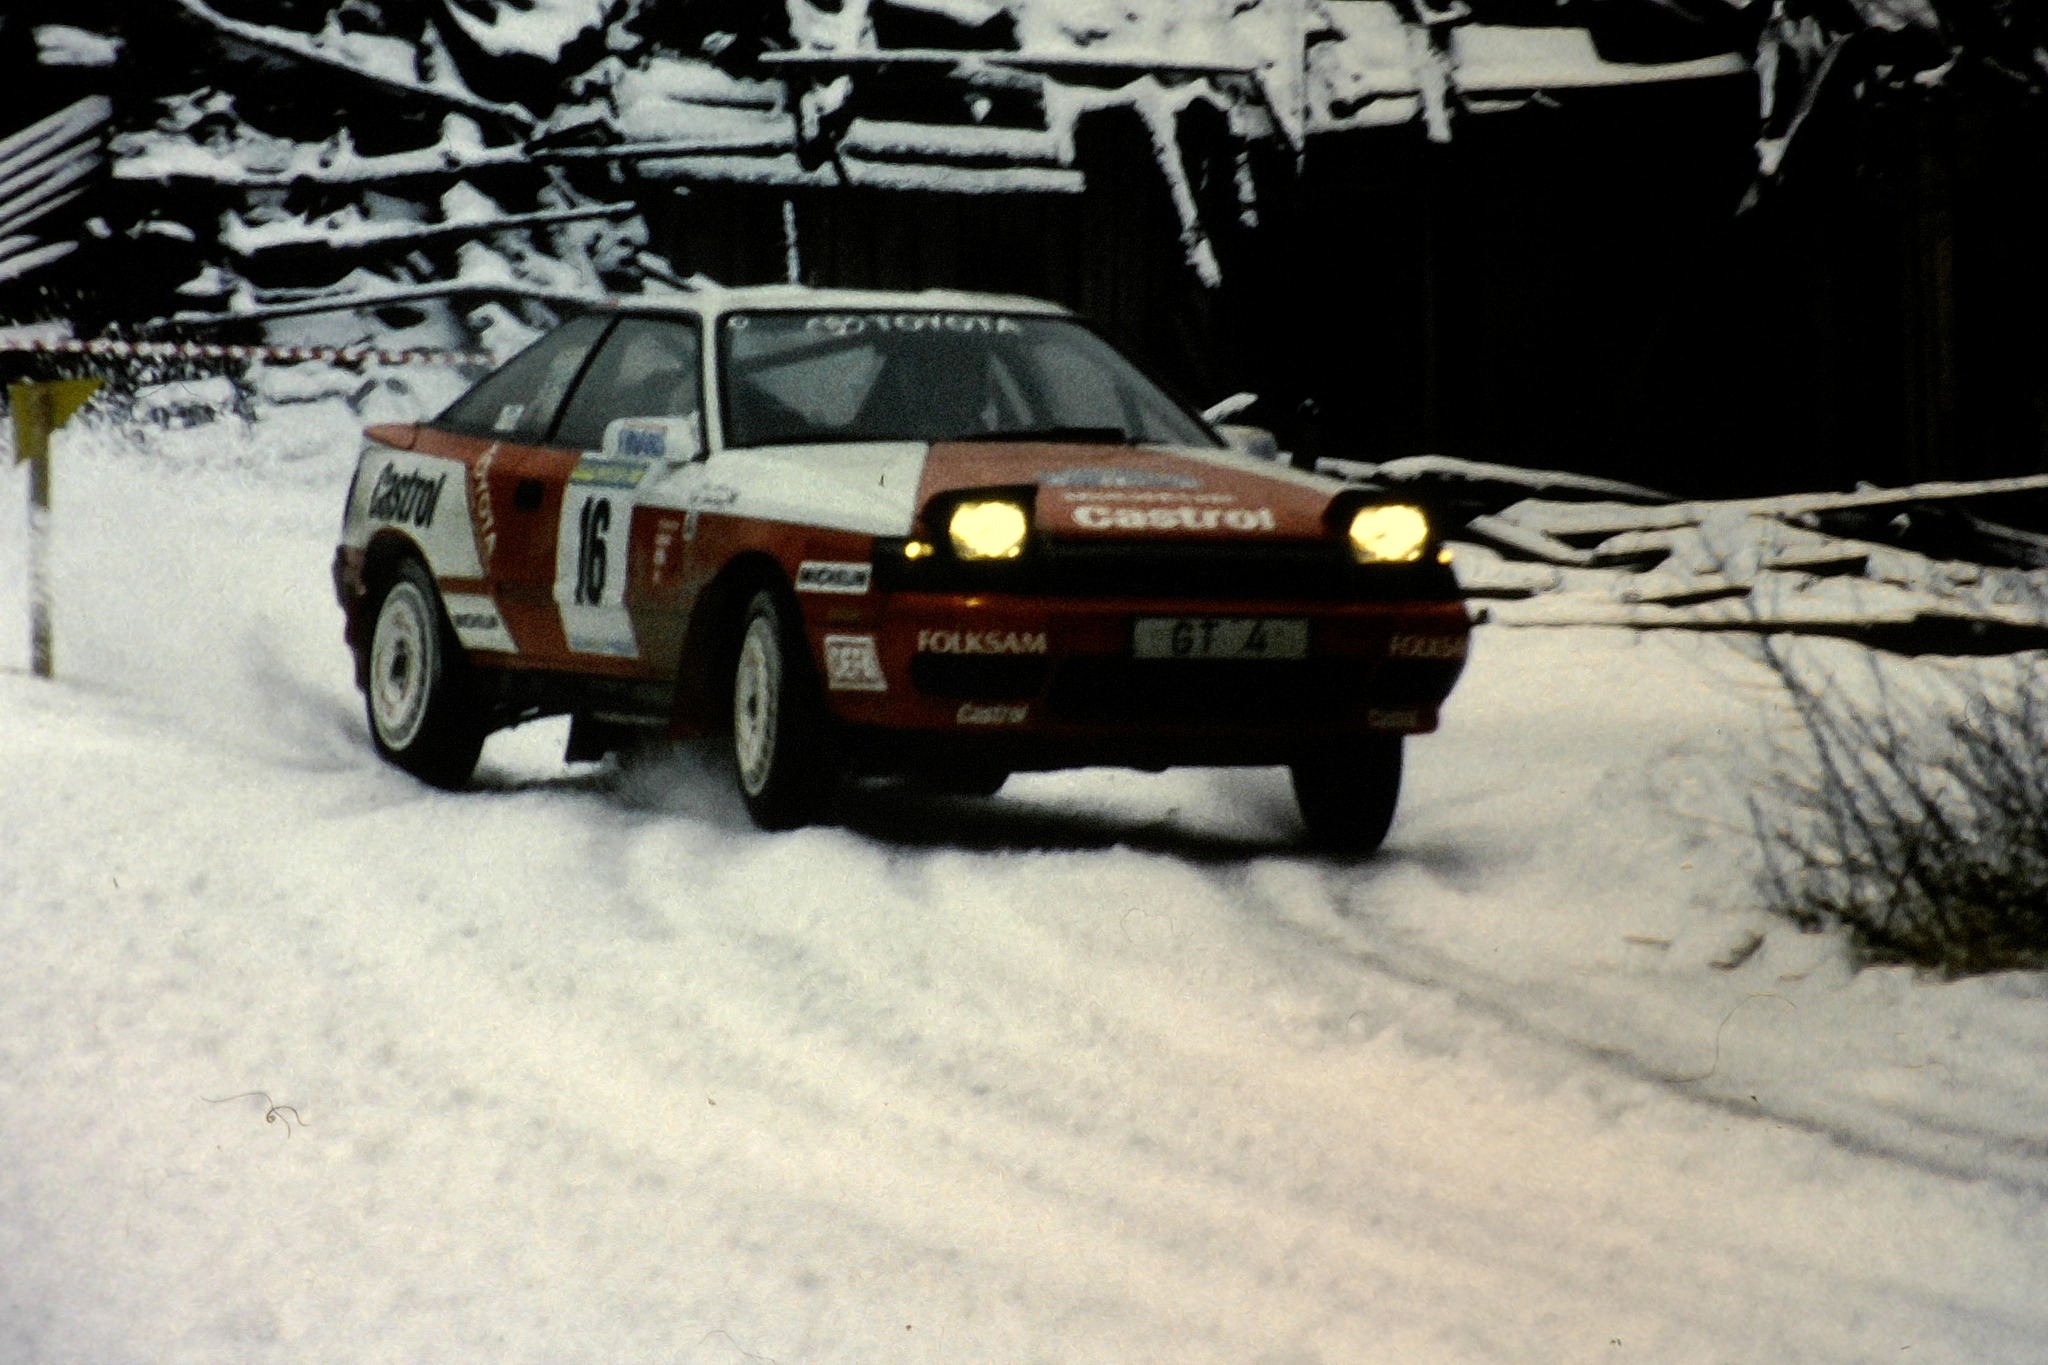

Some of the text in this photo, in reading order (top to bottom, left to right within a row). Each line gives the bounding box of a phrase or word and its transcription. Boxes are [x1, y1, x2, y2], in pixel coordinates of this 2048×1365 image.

[368, 462, 447, 529] Castrol
[1071, 506, 1276, 530] Castrol
[575, 496, 612, 606] 16
[917, 629, 1047, 653] FOLKSAM
